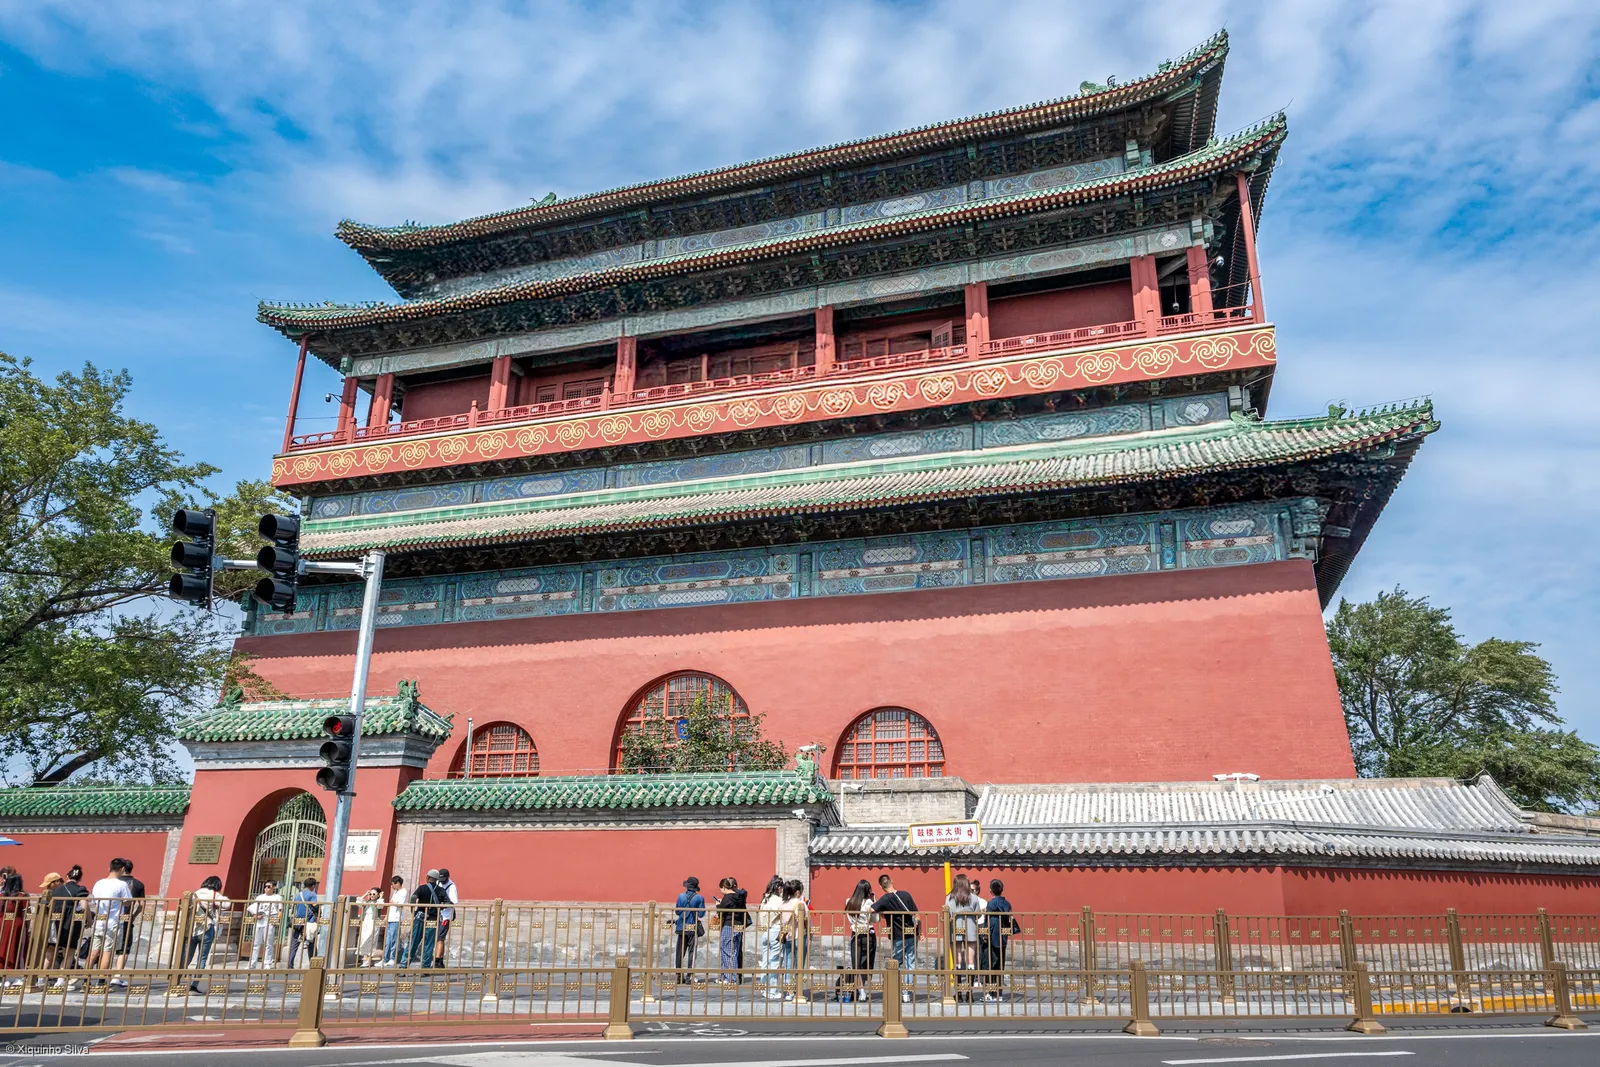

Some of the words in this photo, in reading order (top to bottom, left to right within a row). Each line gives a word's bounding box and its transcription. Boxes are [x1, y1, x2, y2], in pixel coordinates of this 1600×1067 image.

[917, 827, 962, 837] 鼓楼东大街
